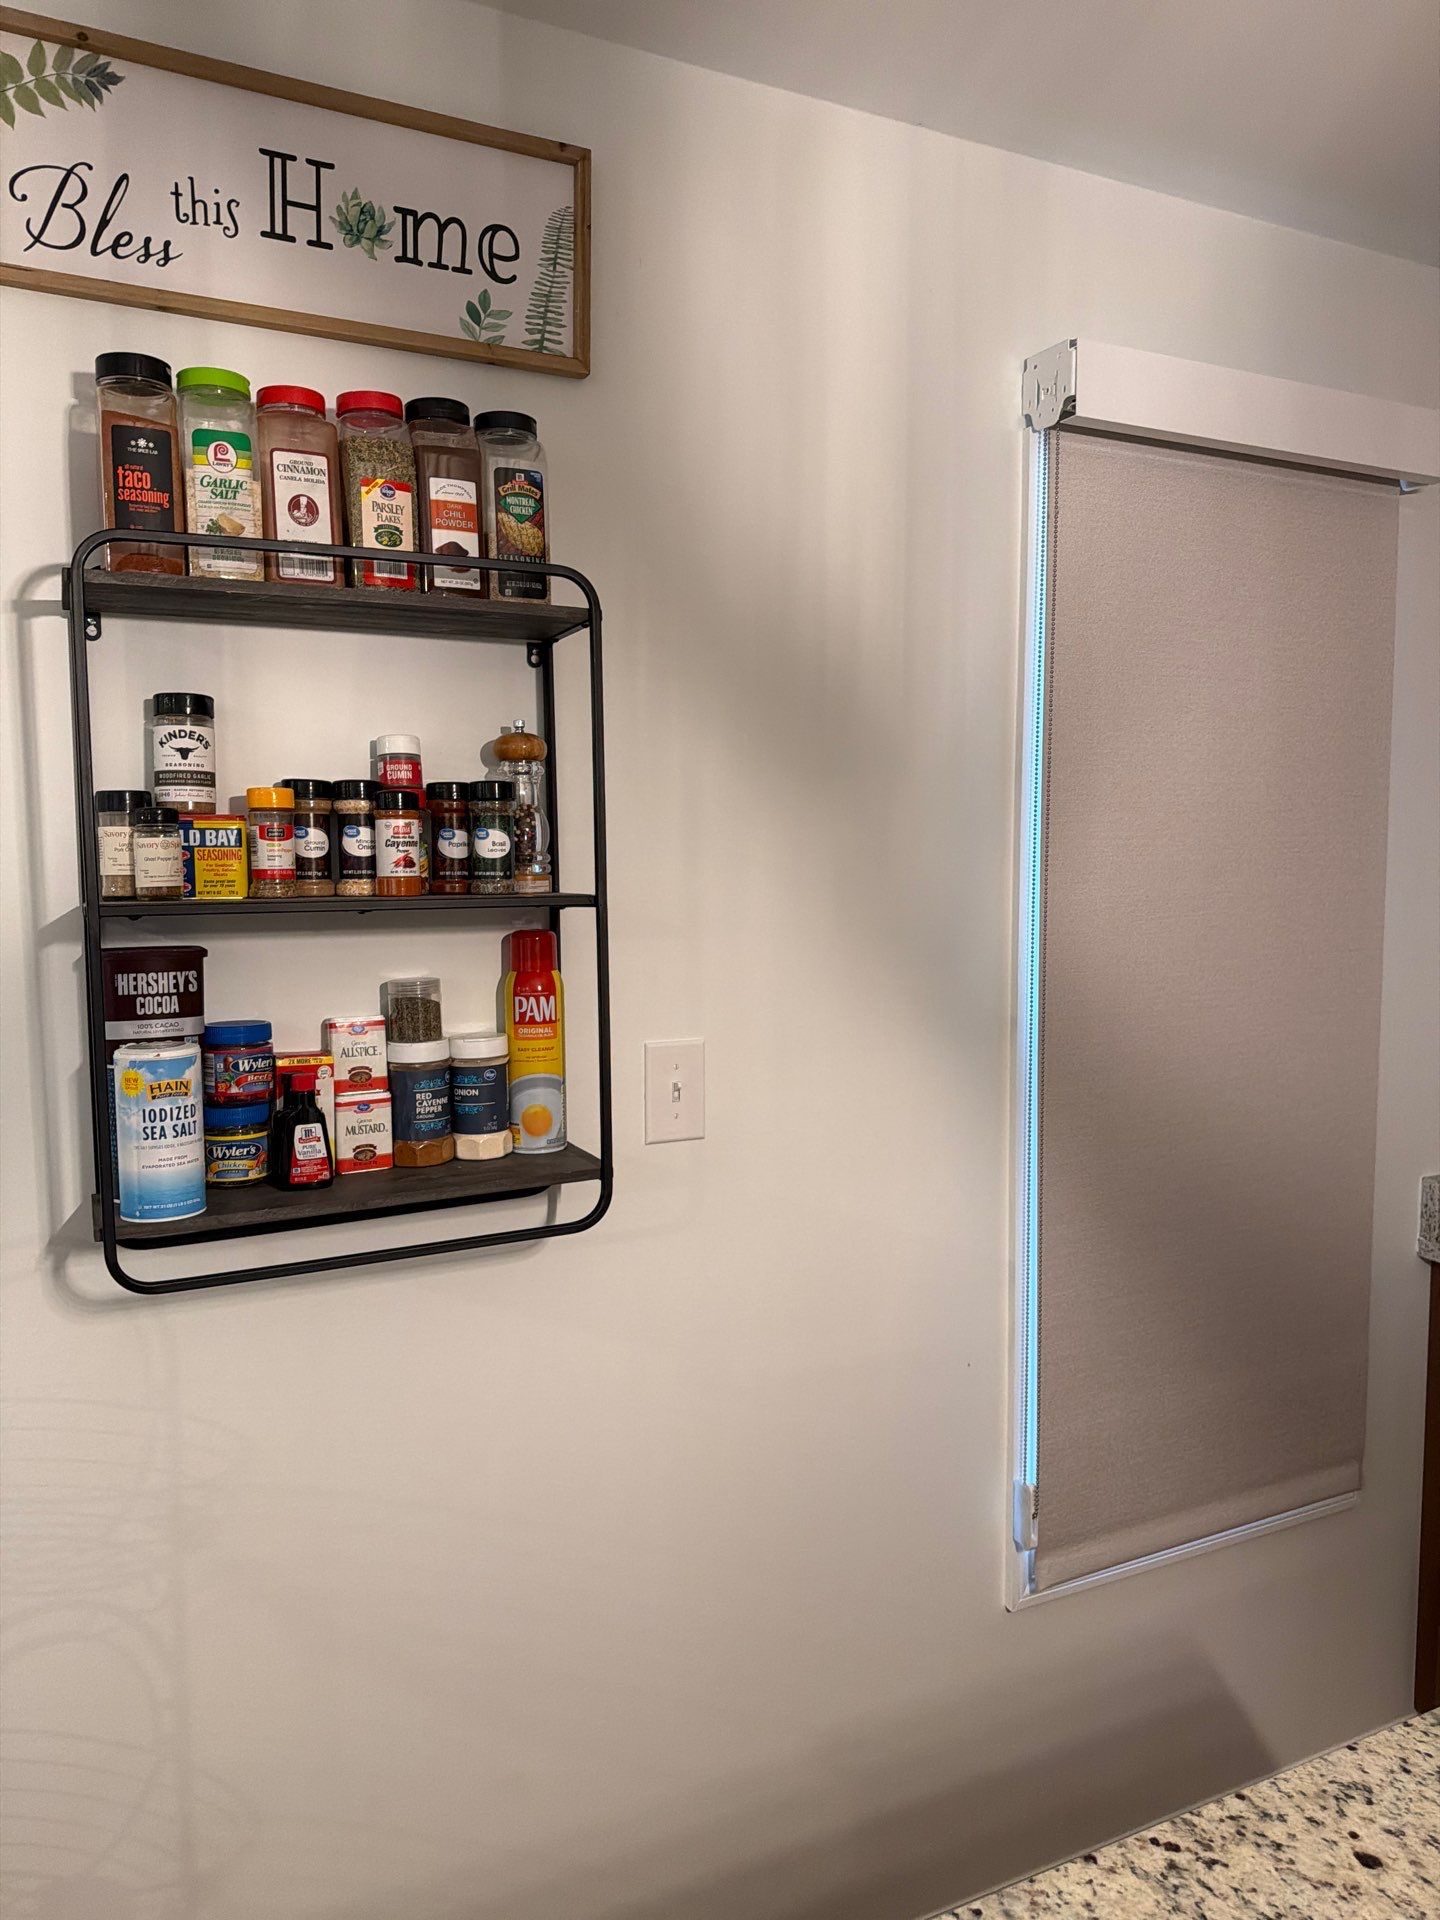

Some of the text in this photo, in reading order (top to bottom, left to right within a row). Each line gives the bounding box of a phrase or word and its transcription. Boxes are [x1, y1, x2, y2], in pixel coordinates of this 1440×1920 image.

[9, 148, 520, 285] Bless this Hme
[277, 464, 326, 477] CINNAMON
[117, 466, 151, 489] taco
[200, 475, 248, 490] GARLIC
[118, 488, 170, 508] seasoning
[210, 488, 240, 500] SALT
[372, 501, 405, 515] PARSLEY
[506, 497, 535, 507] MONTREAL
[443, 509, 466, 518] CHILI
[510, 505, 534, 515] CHICKEN
[376, 513, 401, 524] FLAKES
[436, 518, 474, 529] POWDER
[158, 729, 211, 750] KINDER'S
[387, 770, 412, 779] CUMIN
[179, 829, 237, 846] LD BAY
[385, 839, 418, 849] Cayenne
[137, 842, 159, 850] Savory
[197, 849, 242, 861] SEASONING
[117, 970, 198, 996] HERSHEY'S
[136, 995, 179, 1015] COCOA
[514, 995, 556, 1023] PAM
[340, 1045, 378, 1058] ALLSPICE
[150, 1081, 188, 1094] HAIN
[416, 1096, 448, 1107] CAYENNE
[142, 1104, 196, 1124] IODIZED
[416, 1105, 442, 1114] PEPPER
[143, 1121, 197, 1140] SEA SALT
[345, 1122, 386, 1136] MUSTARD
[212, 1146, 256, 1158] Wyler's
[218, 1161, 246, 1169] Chicken
